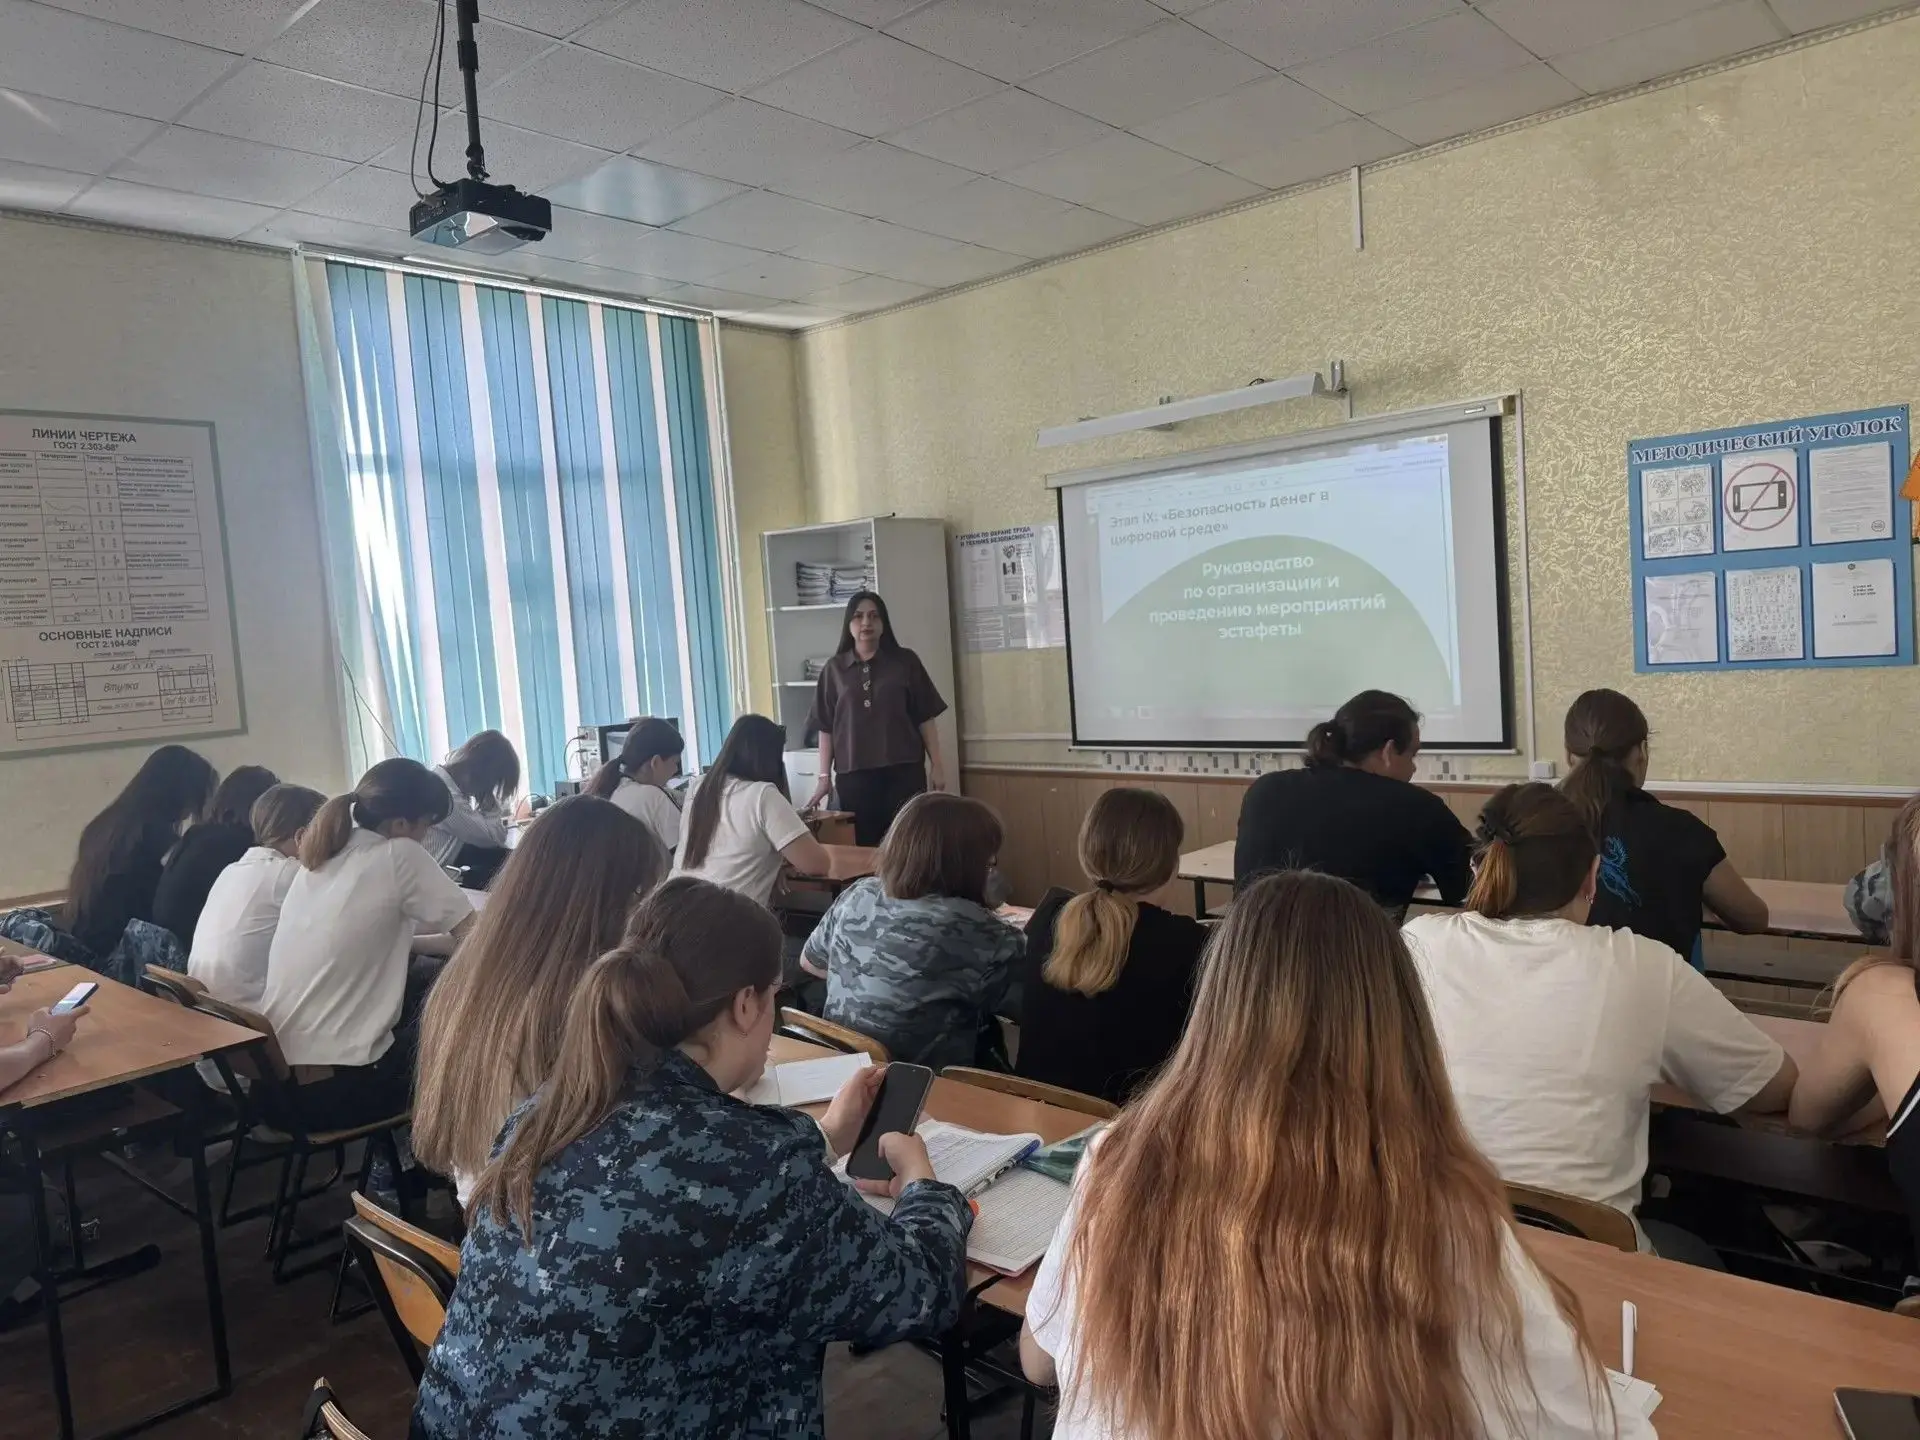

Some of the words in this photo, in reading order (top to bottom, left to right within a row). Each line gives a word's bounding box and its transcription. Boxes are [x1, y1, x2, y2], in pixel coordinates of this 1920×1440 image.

[31, 428, 77, 440] ЛИНИИ
[79, 431, 137, 443] ЧЕРТЕЖА
[53, 441, 78, 450] ГОСТ
[1632, 427, 1803, 465] МЕТОДИЧЕСКИЙ
[1807, 415, 1902, 442] УГОЛОК
[1110, 516, 1139, 528] Этап
[1142, 513, 1160, 523] IX:
[1161, 500, 1267, 521] «Безопасность
[1269, 492, 1316, 509] денег
[1320, 491, 1329, 501] в
[1110, 526, 1177, 547] цифровой
[1180, 523, 1229, 538] среде»
[1202, 555, 1315, 579] Руководство
[1183, 586, 1203, 599] по
[1207, 577, 1321, 598] организации
[1328, 575, 1340, 589] и
[1149, 606, 1252, 626] проведению
[1256, 593, 1387, 617] мероприятий
[38, 628, 112, 642] ОСНОВНЫЕ
[115, 626, 173, 639] НАДПИСИ
[1218, 621, 1302, 641] эстафеты
[76, 640, 101, 650] ГОСТ
